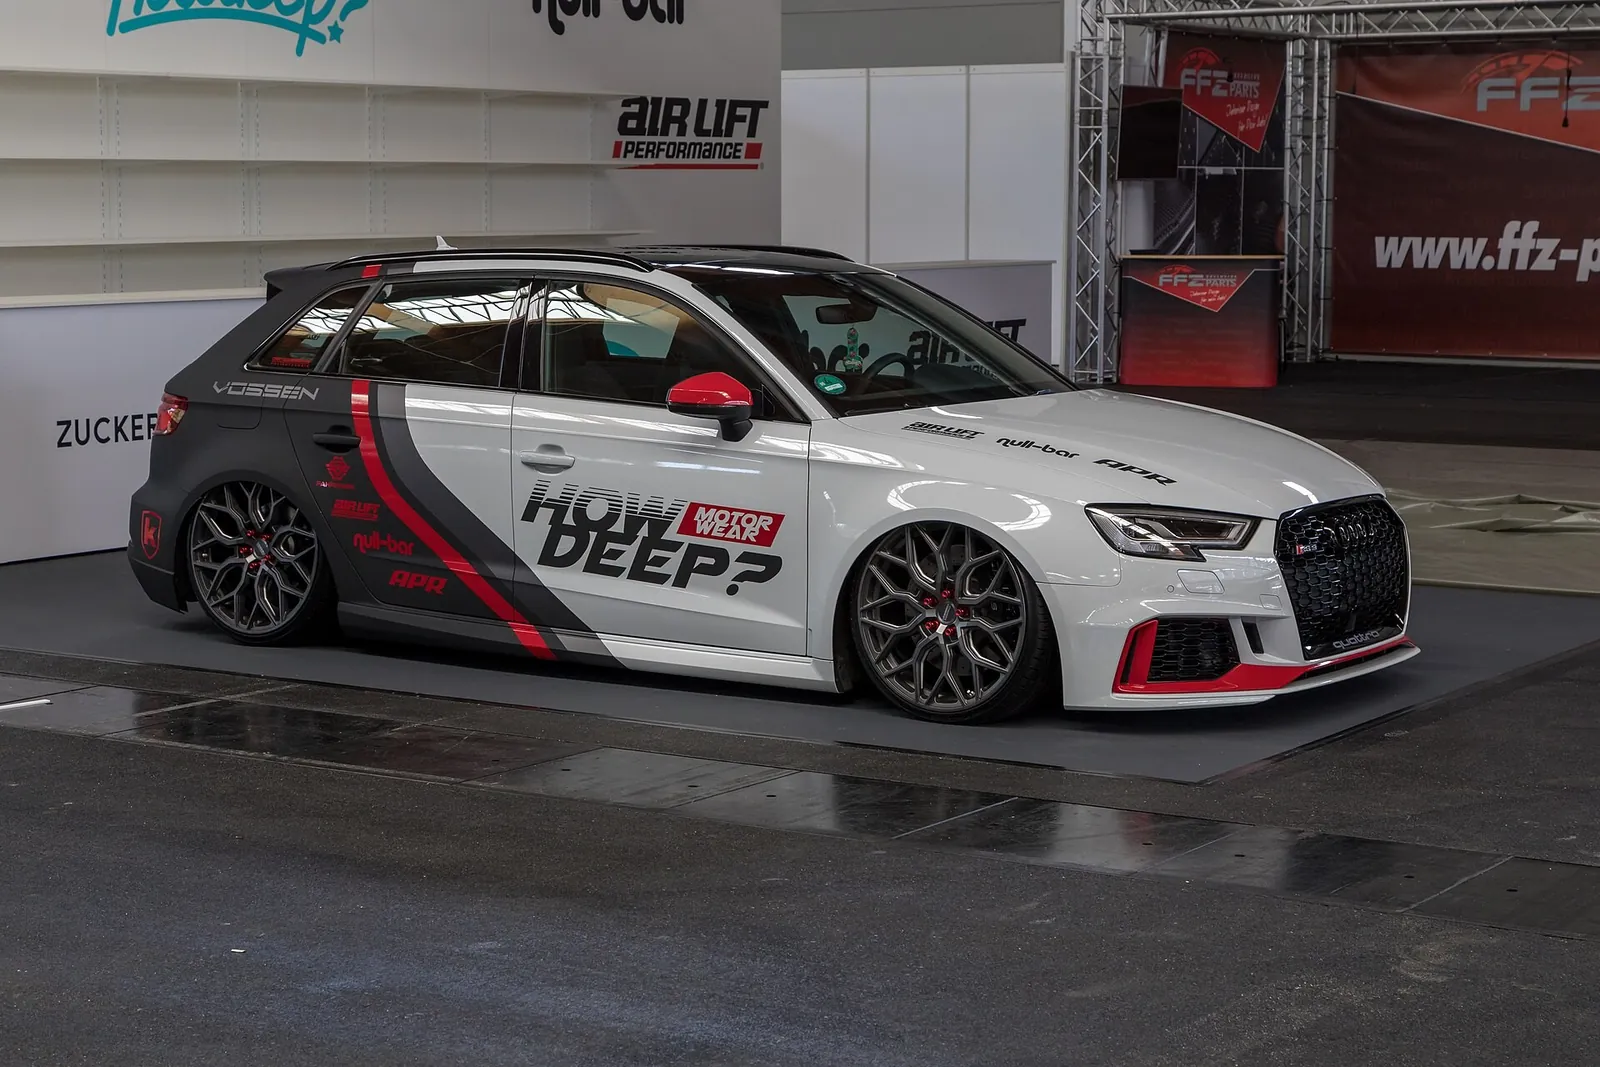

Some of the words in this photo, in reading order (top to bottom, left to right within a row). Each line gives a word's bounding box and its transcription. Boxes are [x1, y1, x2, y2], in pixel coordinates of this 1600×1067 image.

[1181, 68, 1228, 97] FFZ
[1229, 80, 1260, 99] PARTS
[693, 98, 769, 138] LIFT
[1158, 274, 1204, 287] FFZ
[1205, 278, 1237, 288] PARTS
[212, 381, 320, 401] VOSSEN
[996, 437, 1080, 459] null-bar
[1093, 458, 1177, 487] APR
[521, 479, 688, 540] HOW
[694, 506, 774, 532] MOTOR
[353, 531, 415, 555] null-bar
[695, 519, 760, 543] WEAR
[536, 523, 783, 597] DEEP?
[389, 569, 448, 595] APR
[1332, 630, 1380, 650] quattro
